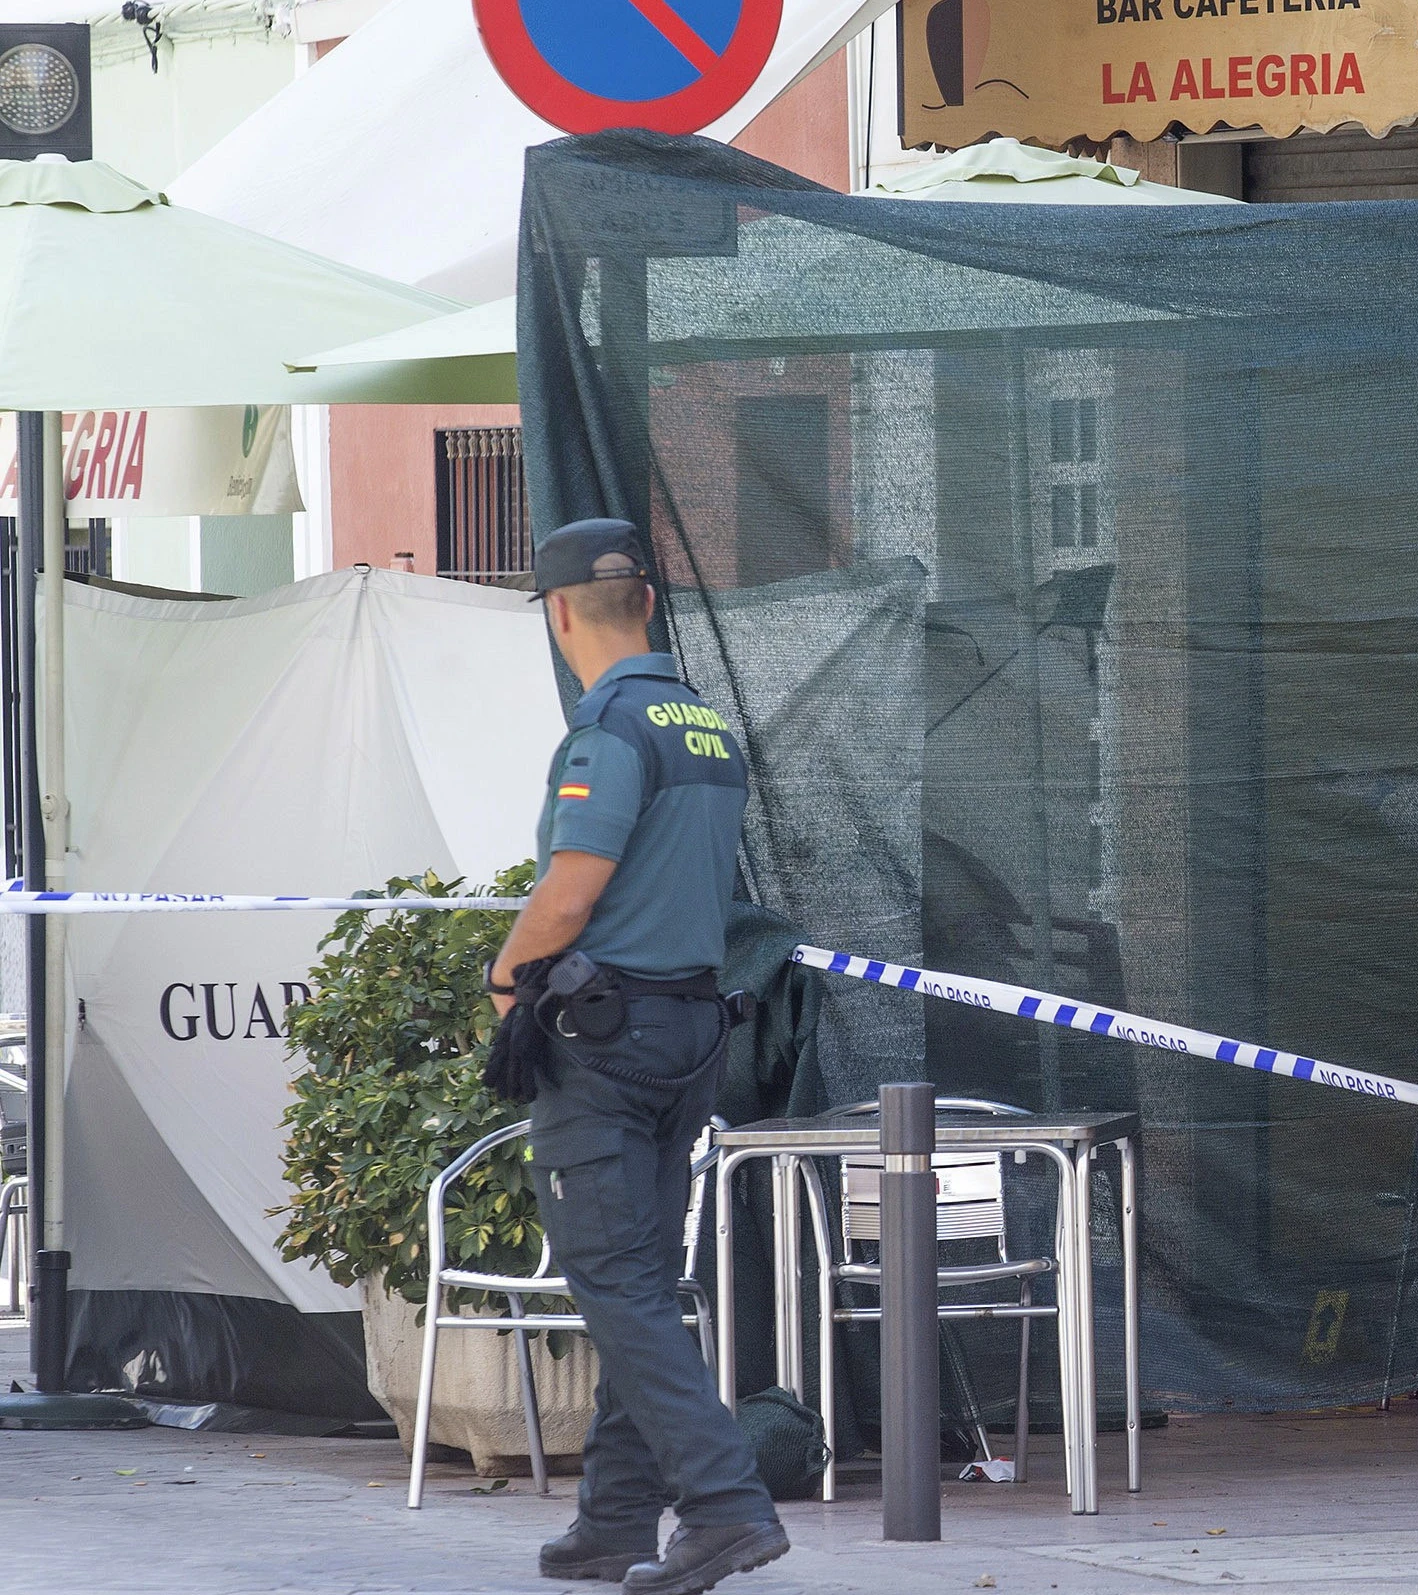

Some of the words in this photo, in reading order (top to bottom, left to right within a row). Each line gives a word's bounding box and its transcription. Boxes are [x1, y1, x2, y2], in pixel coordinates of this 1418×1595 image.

[1097, 0, 1163, 24] BAR
[1102, 62, 1157, 104] LA
[1169, 52, 1365, 101] ALEGRIA
[685, 730, 730, 759] CIVIL
[1345, 1075, 1398, 1101] PASAR
